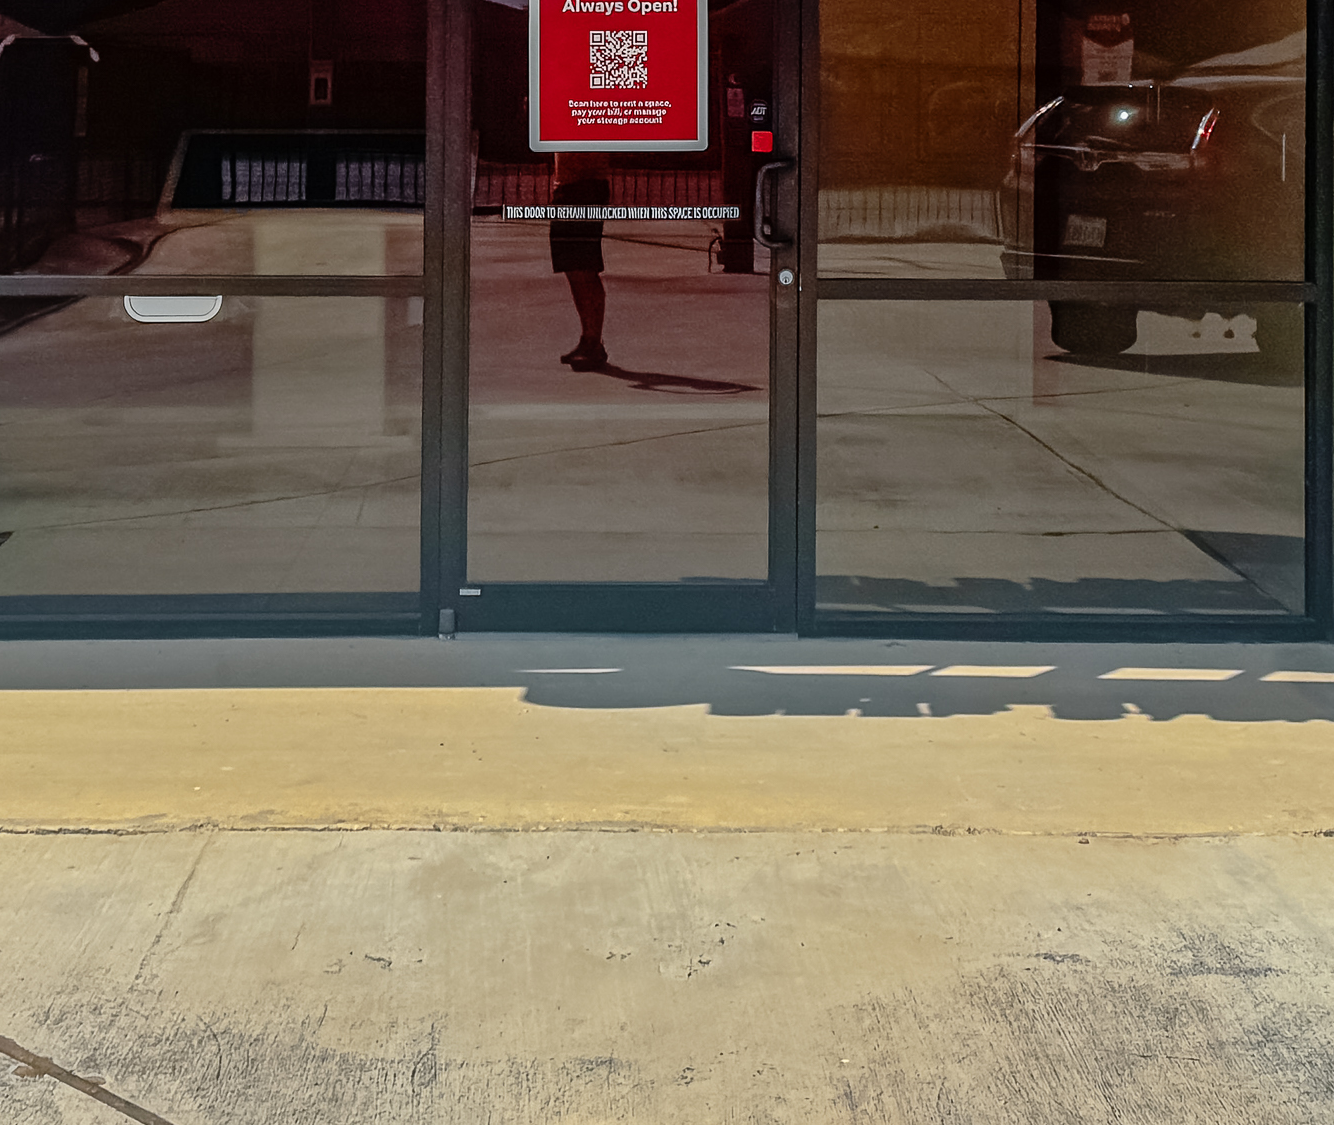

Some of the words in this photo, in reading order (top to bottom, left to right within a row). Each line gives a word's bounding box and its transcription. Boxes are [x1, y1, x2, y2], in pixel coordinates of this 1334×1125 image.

[750, 106, 767, 116] ADT
[507, 206, 524, 219] THIS
[524, 206, 546, 219] DOOR
[547, 206, 556, 219] TO
[557, 206, 586, 219] REMAIN
[587, 206, 627, 219] UNLOCKED
[651, 206, 667, 219] THIS
[668, 206, 693, 219] SPACE
[694, 206, 701, 219] IS
[702, 206, 740, 219] OCCUPIED
